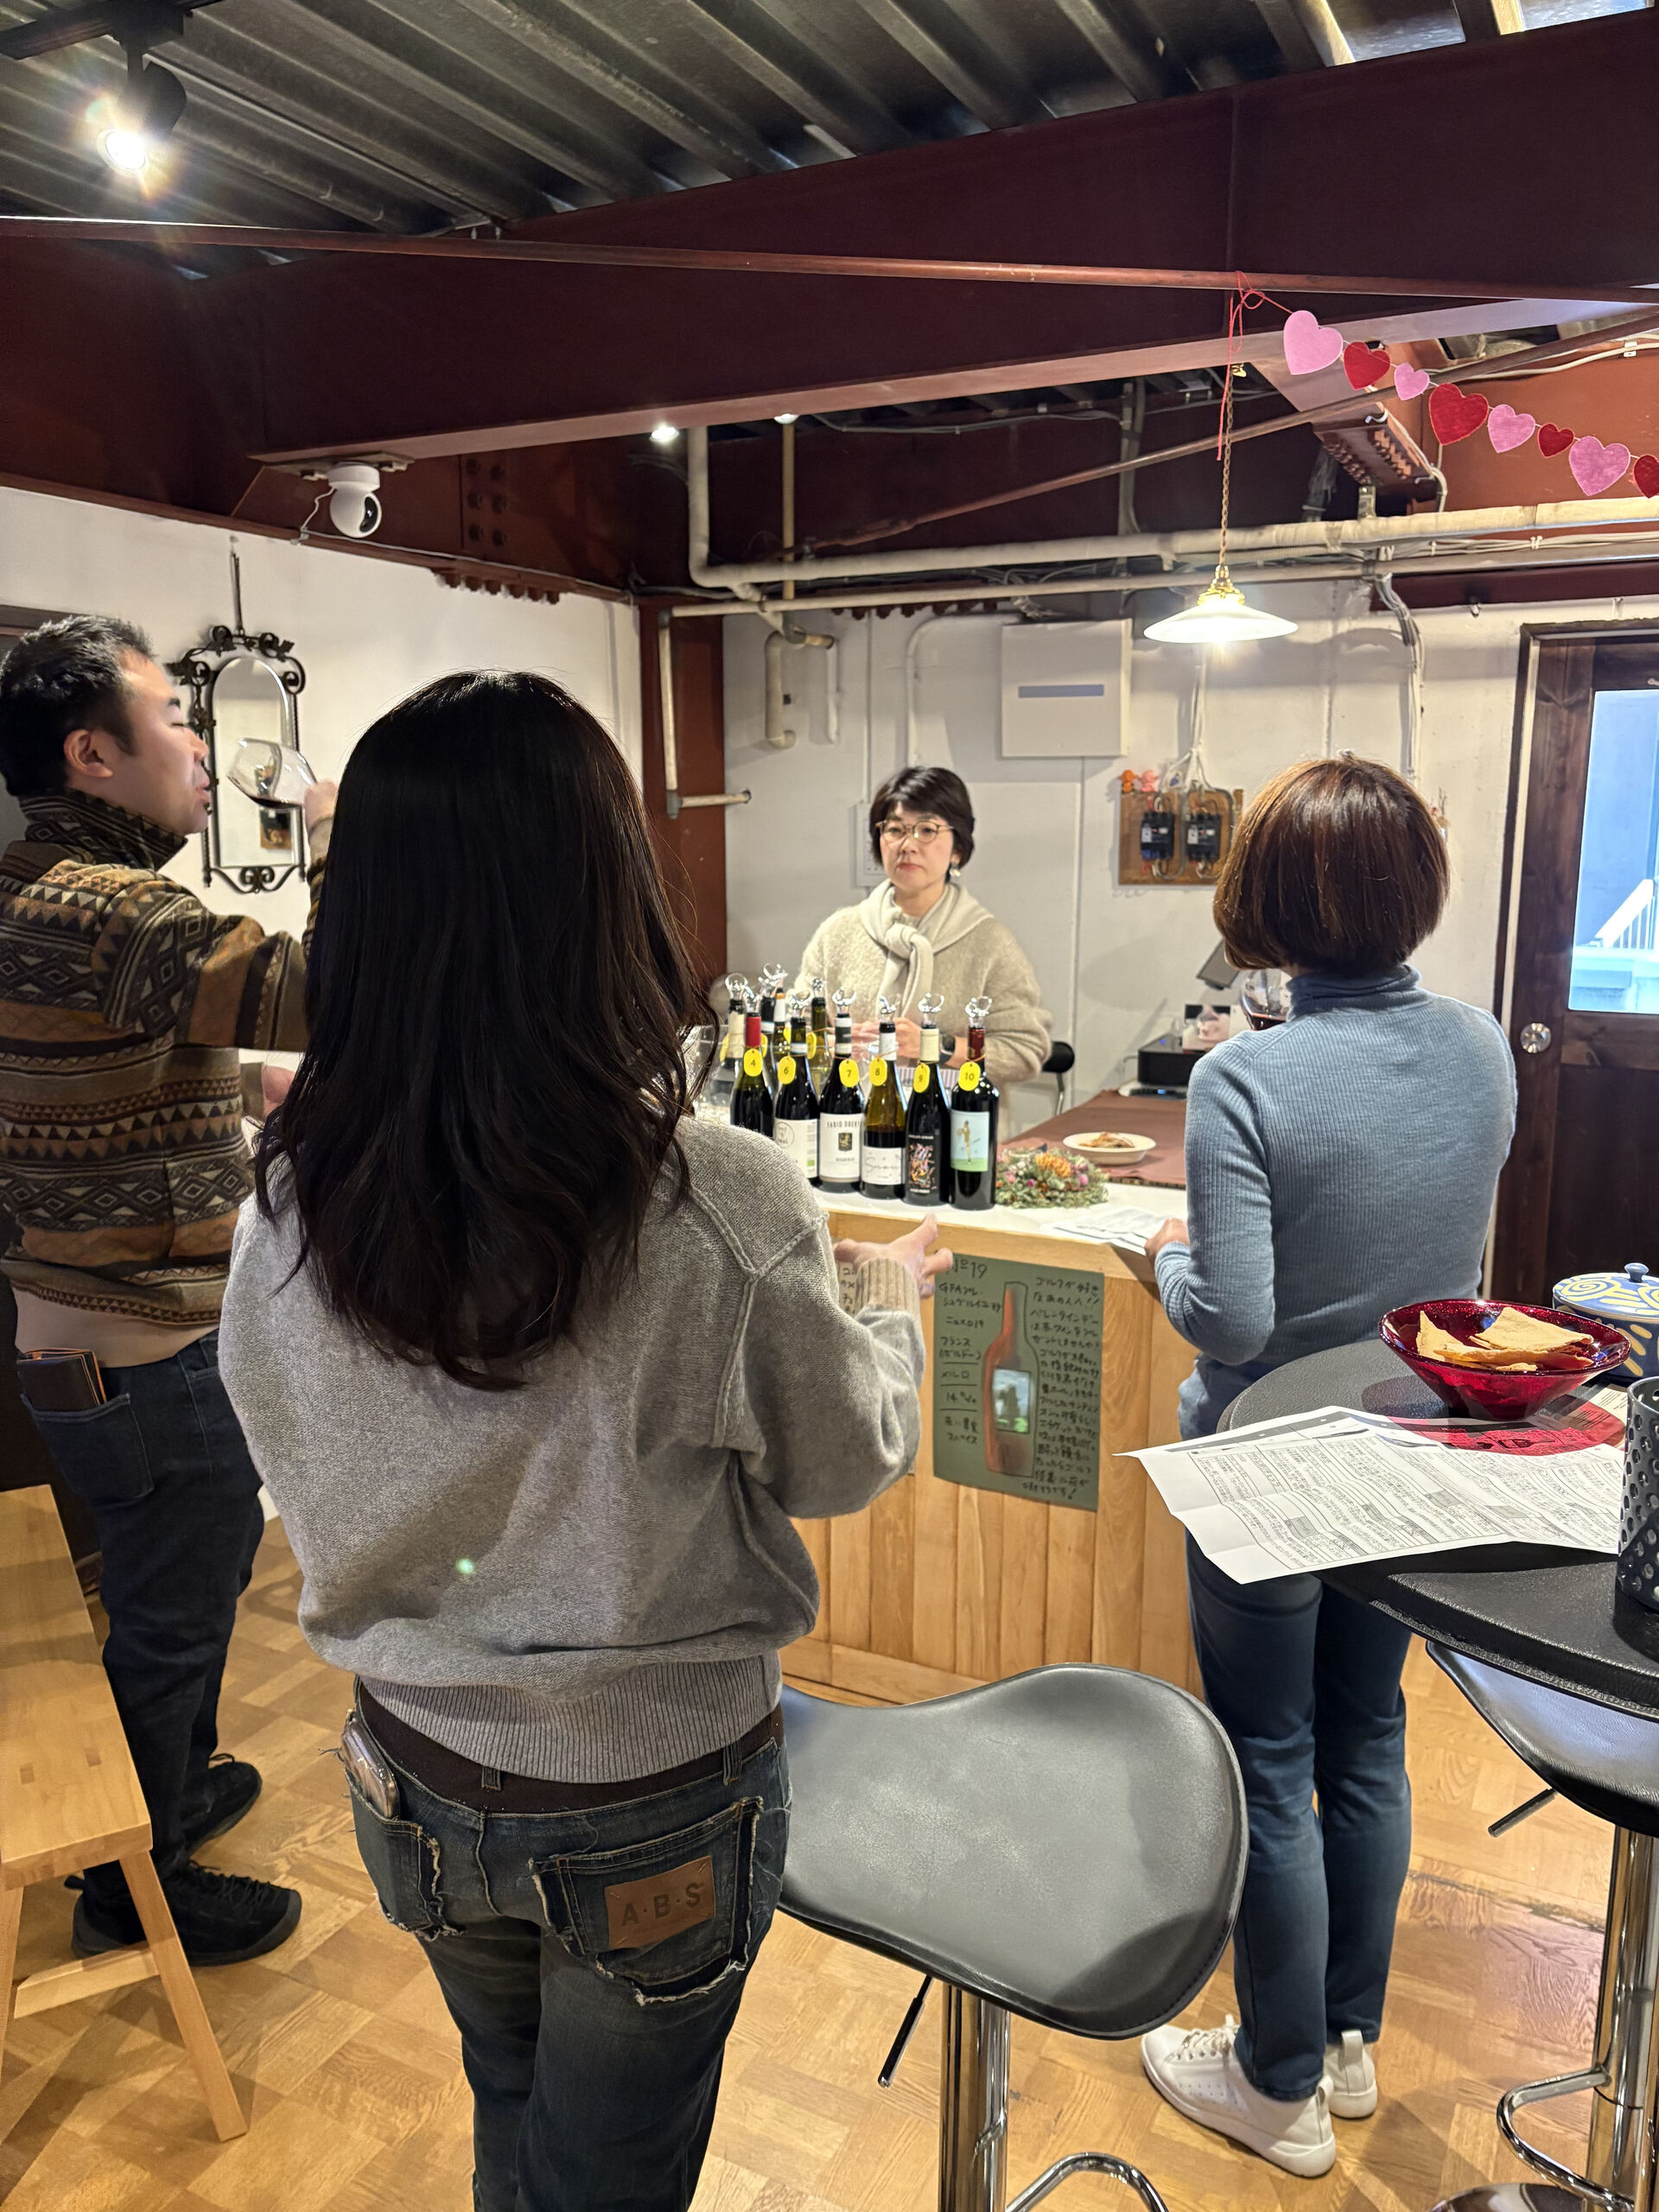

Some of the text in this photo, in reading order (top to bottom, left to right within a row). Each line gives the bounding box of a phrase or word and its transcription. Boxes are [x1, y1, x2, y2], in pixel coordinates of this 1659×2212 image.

[964, 1072, 975, 1081] 10
[970, 1262, 988, 1279] 19
[941, 1336, 970, 1346] フランス
